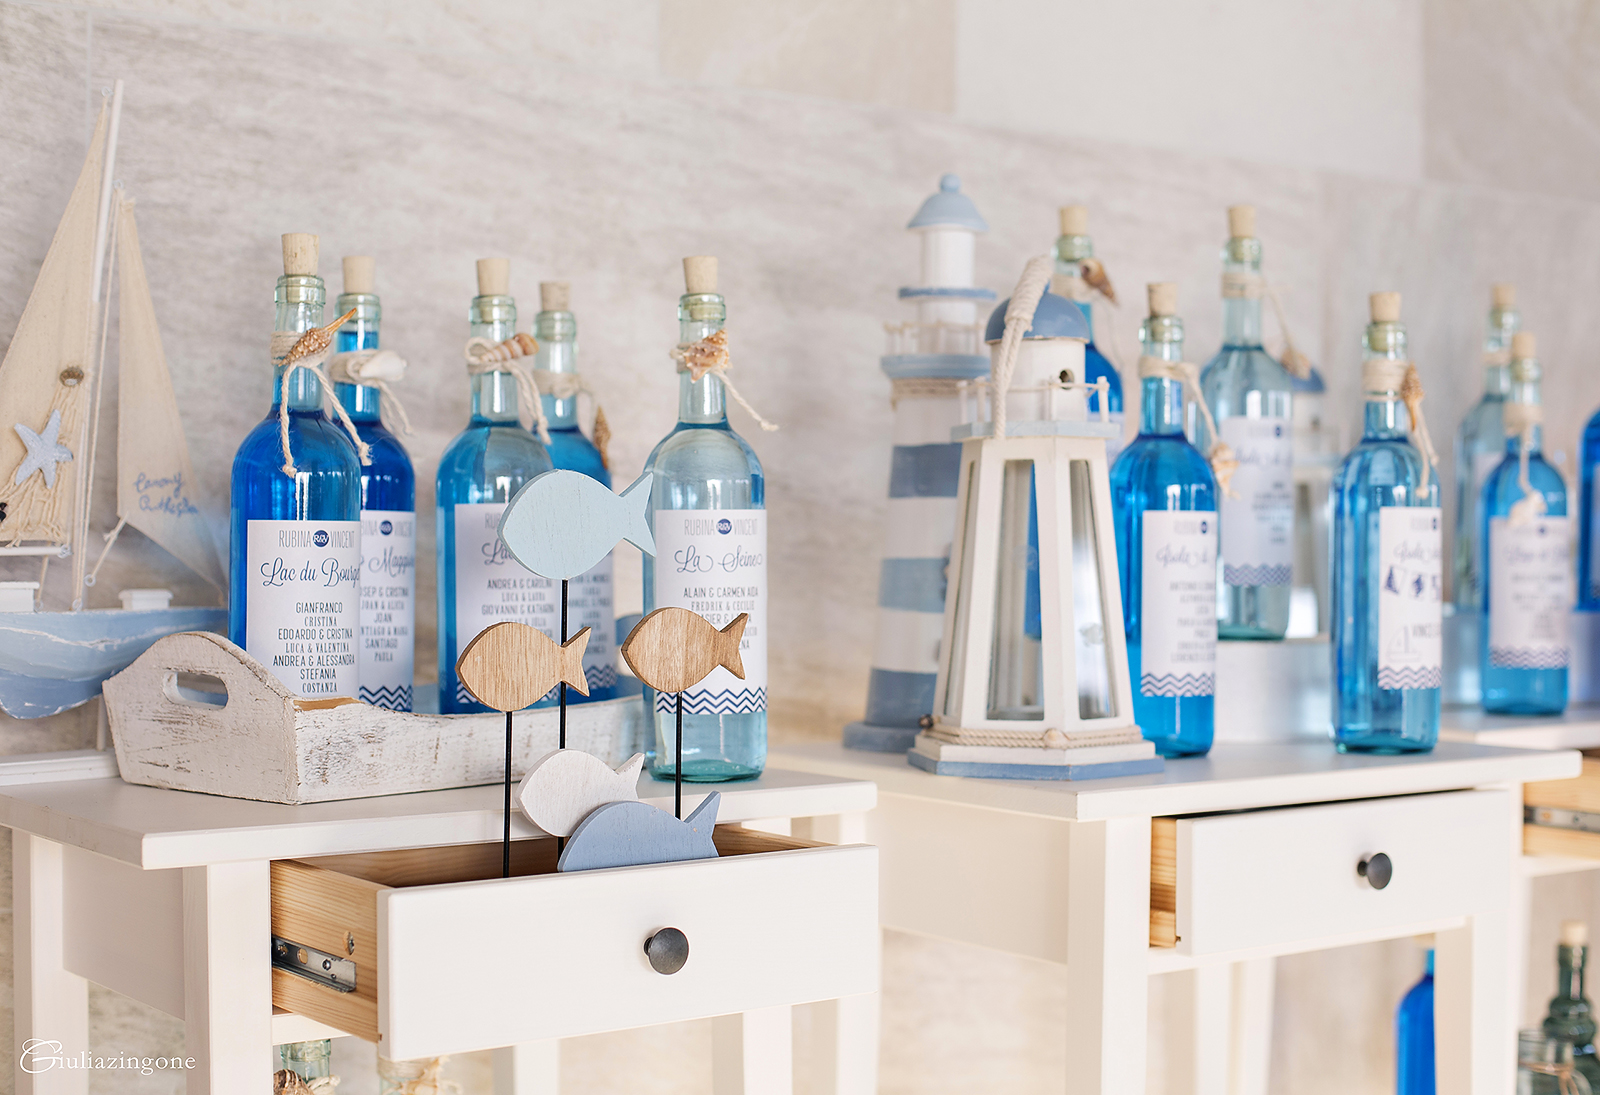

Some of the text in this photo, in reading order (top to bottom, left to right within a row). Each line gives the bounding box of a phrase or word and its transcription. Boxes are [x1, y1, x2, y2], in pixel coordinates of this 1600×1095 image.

[684, 519, 715, 536] RUBINA
[733, 518, 758, 535] VINCENT
[279, 529, 311, 548] RUBINA
[330, 530, 355, 549] VINCENT
[674, 545, 763, 573] La Seine
[260, 557, 297, 587] Lac
[300, 560, 318, 582] du
[487, 579, 517, 590] ANDREA
[519, 579, 525, 589] &
[502, 592, 519, 602] LUCA
[683, 587, 706, 598] ALAIN
[708, 587, 714, 598] &
[716, 587, 746, 598] CARMEN
[296, 602, 343, 614] GIANFRANCO
[481, 604, 518, 615] GIOVANNI
[520, 604, 525, 615] &
[691, 601, 755, 612] FREDRIK & CECILIE
[304, 616, 338, 627] CRISTINA
[278, 628, 353, 640] EDOARDO & CRISTINA
[285, 642, 350, 653] LUCA & VALENTINA
[365, 638, 398, 649] SANTIAGO
[273, 654, 355, 667] ANDREA & ALESSANDRA
[300, 668, 337, 680] STEFANIA
[302, 682, 338, 693] COSTANZA
